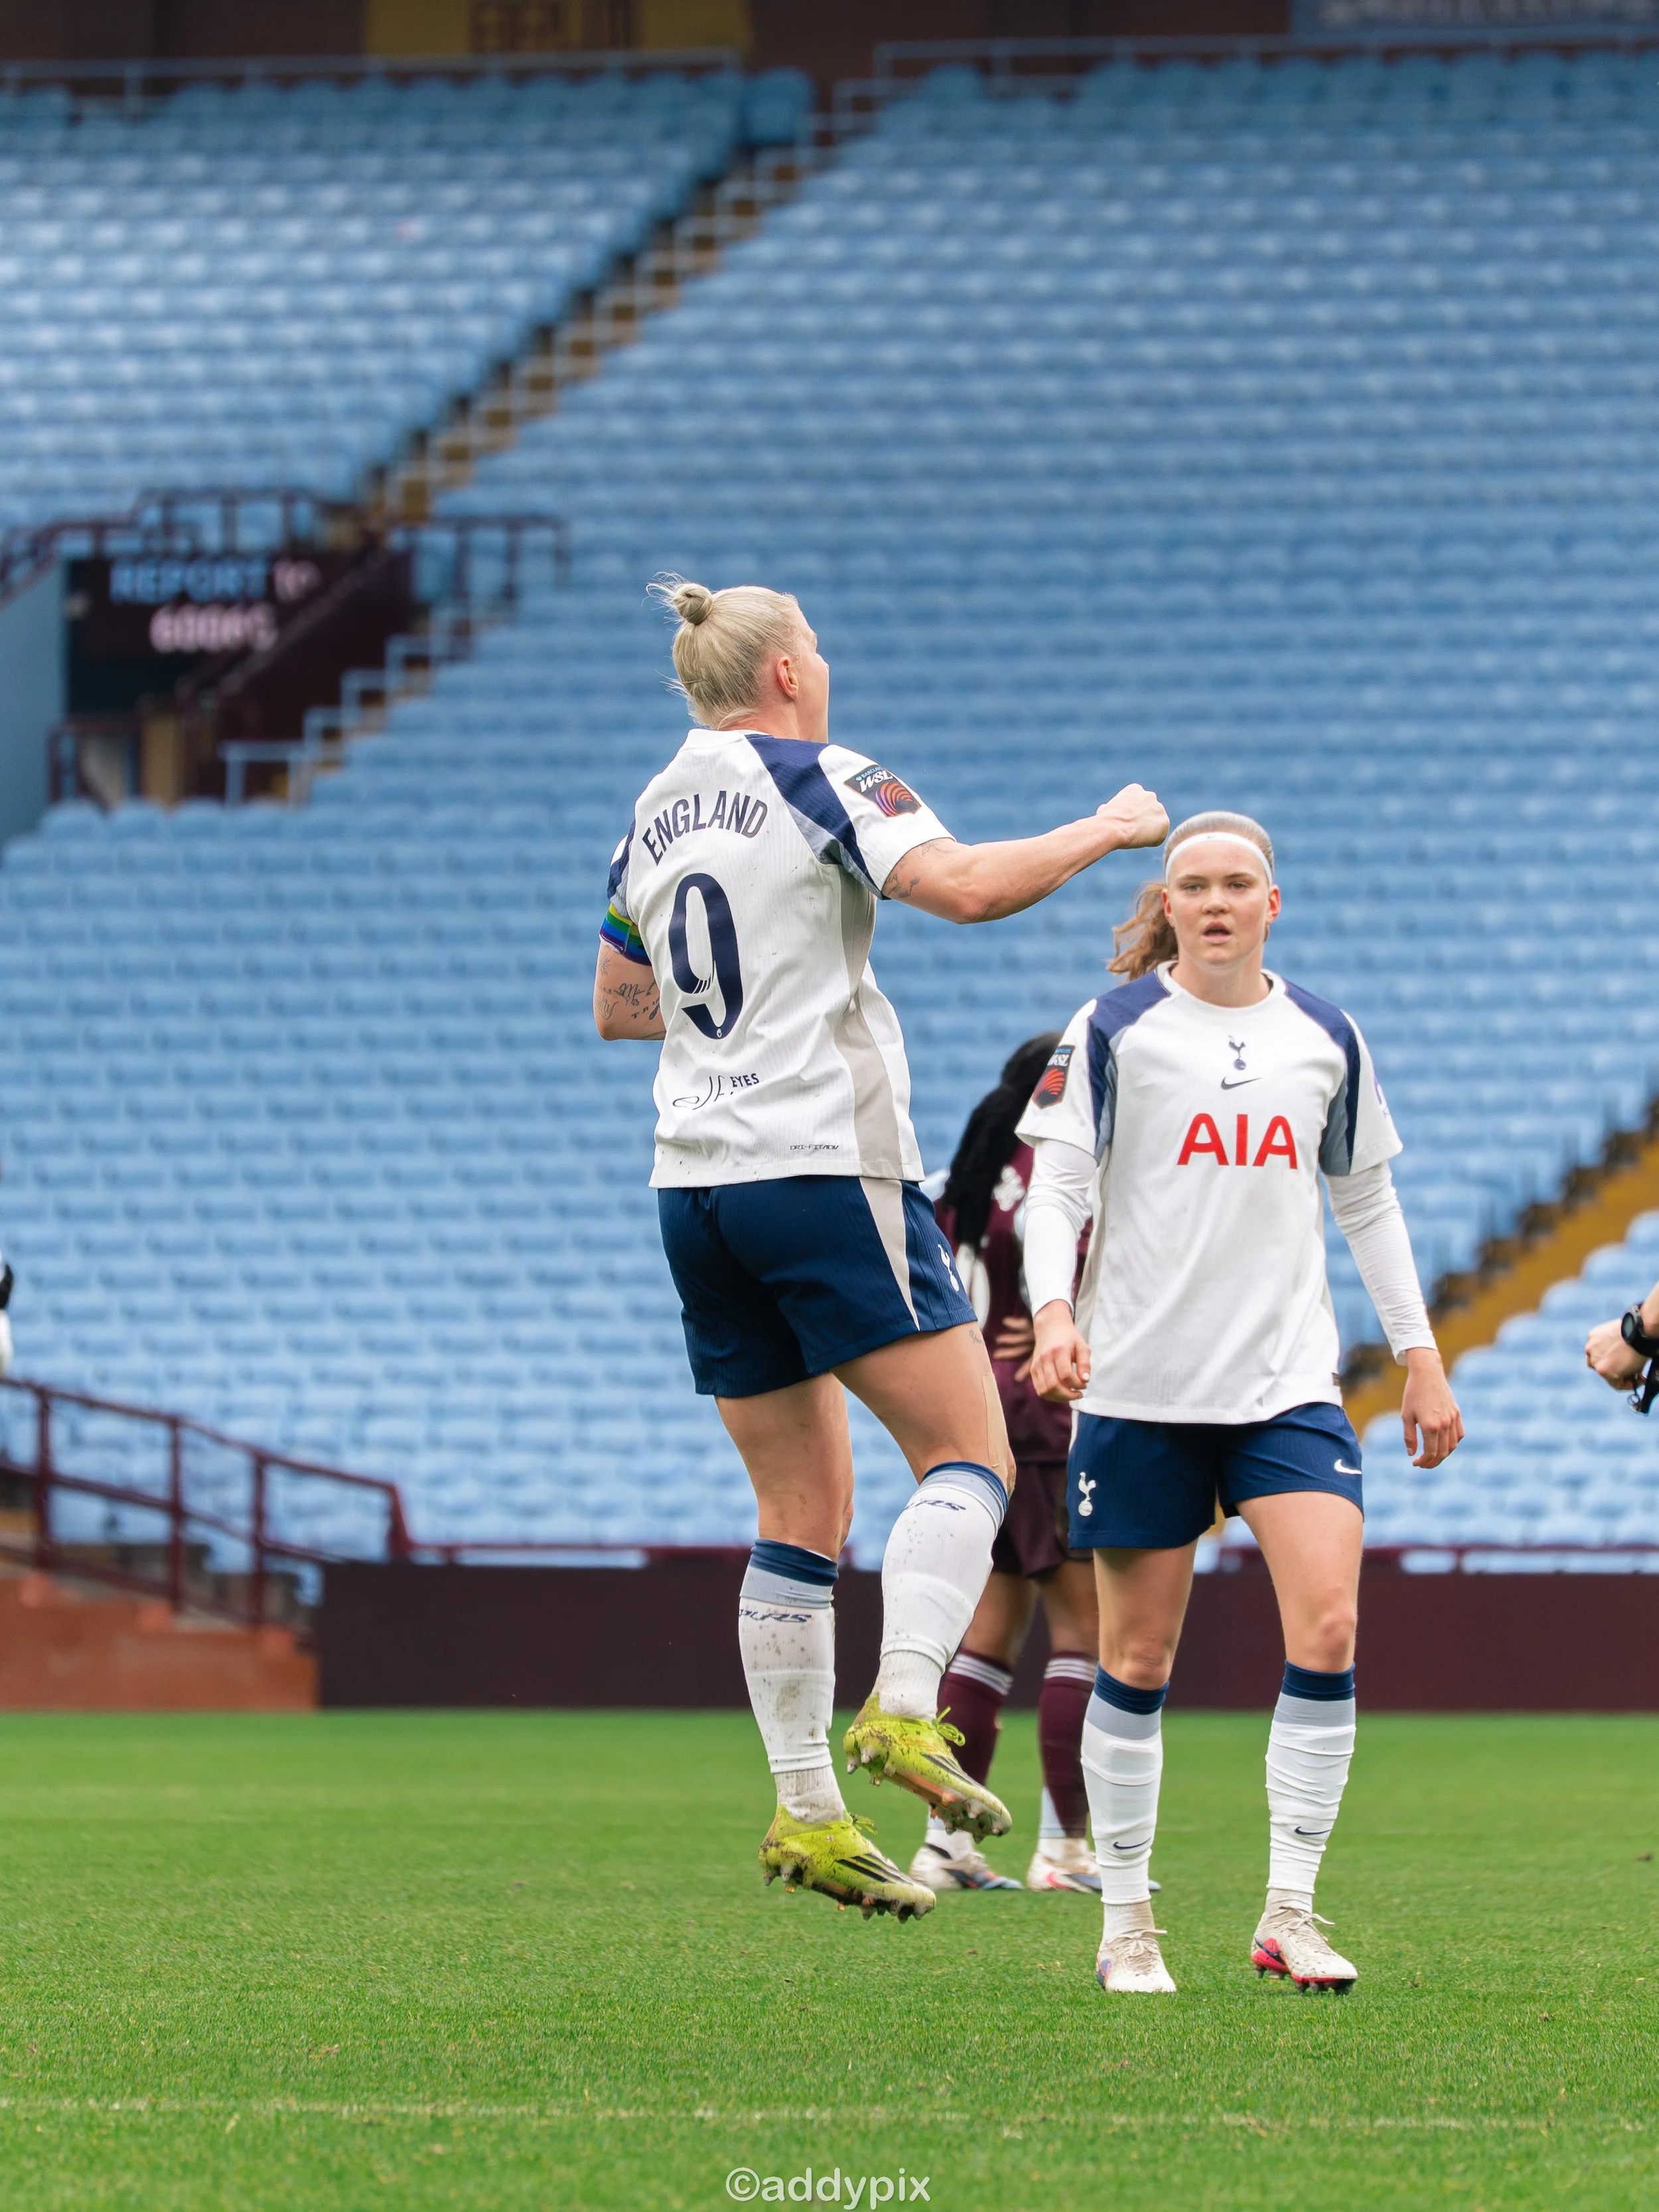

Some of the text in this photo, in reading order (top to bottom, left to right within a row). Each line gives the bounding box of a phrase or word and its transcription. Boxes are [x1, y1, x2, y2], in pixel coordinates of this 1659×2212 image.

[860, 770, 893, 792] WSL
[642, 790, 767, 866] ENGLAND
[668, 873, 743, 1039] 9
[730, 1072, 760, 1088] EYES
[1177, 1113, 1298, 1169] AIA
